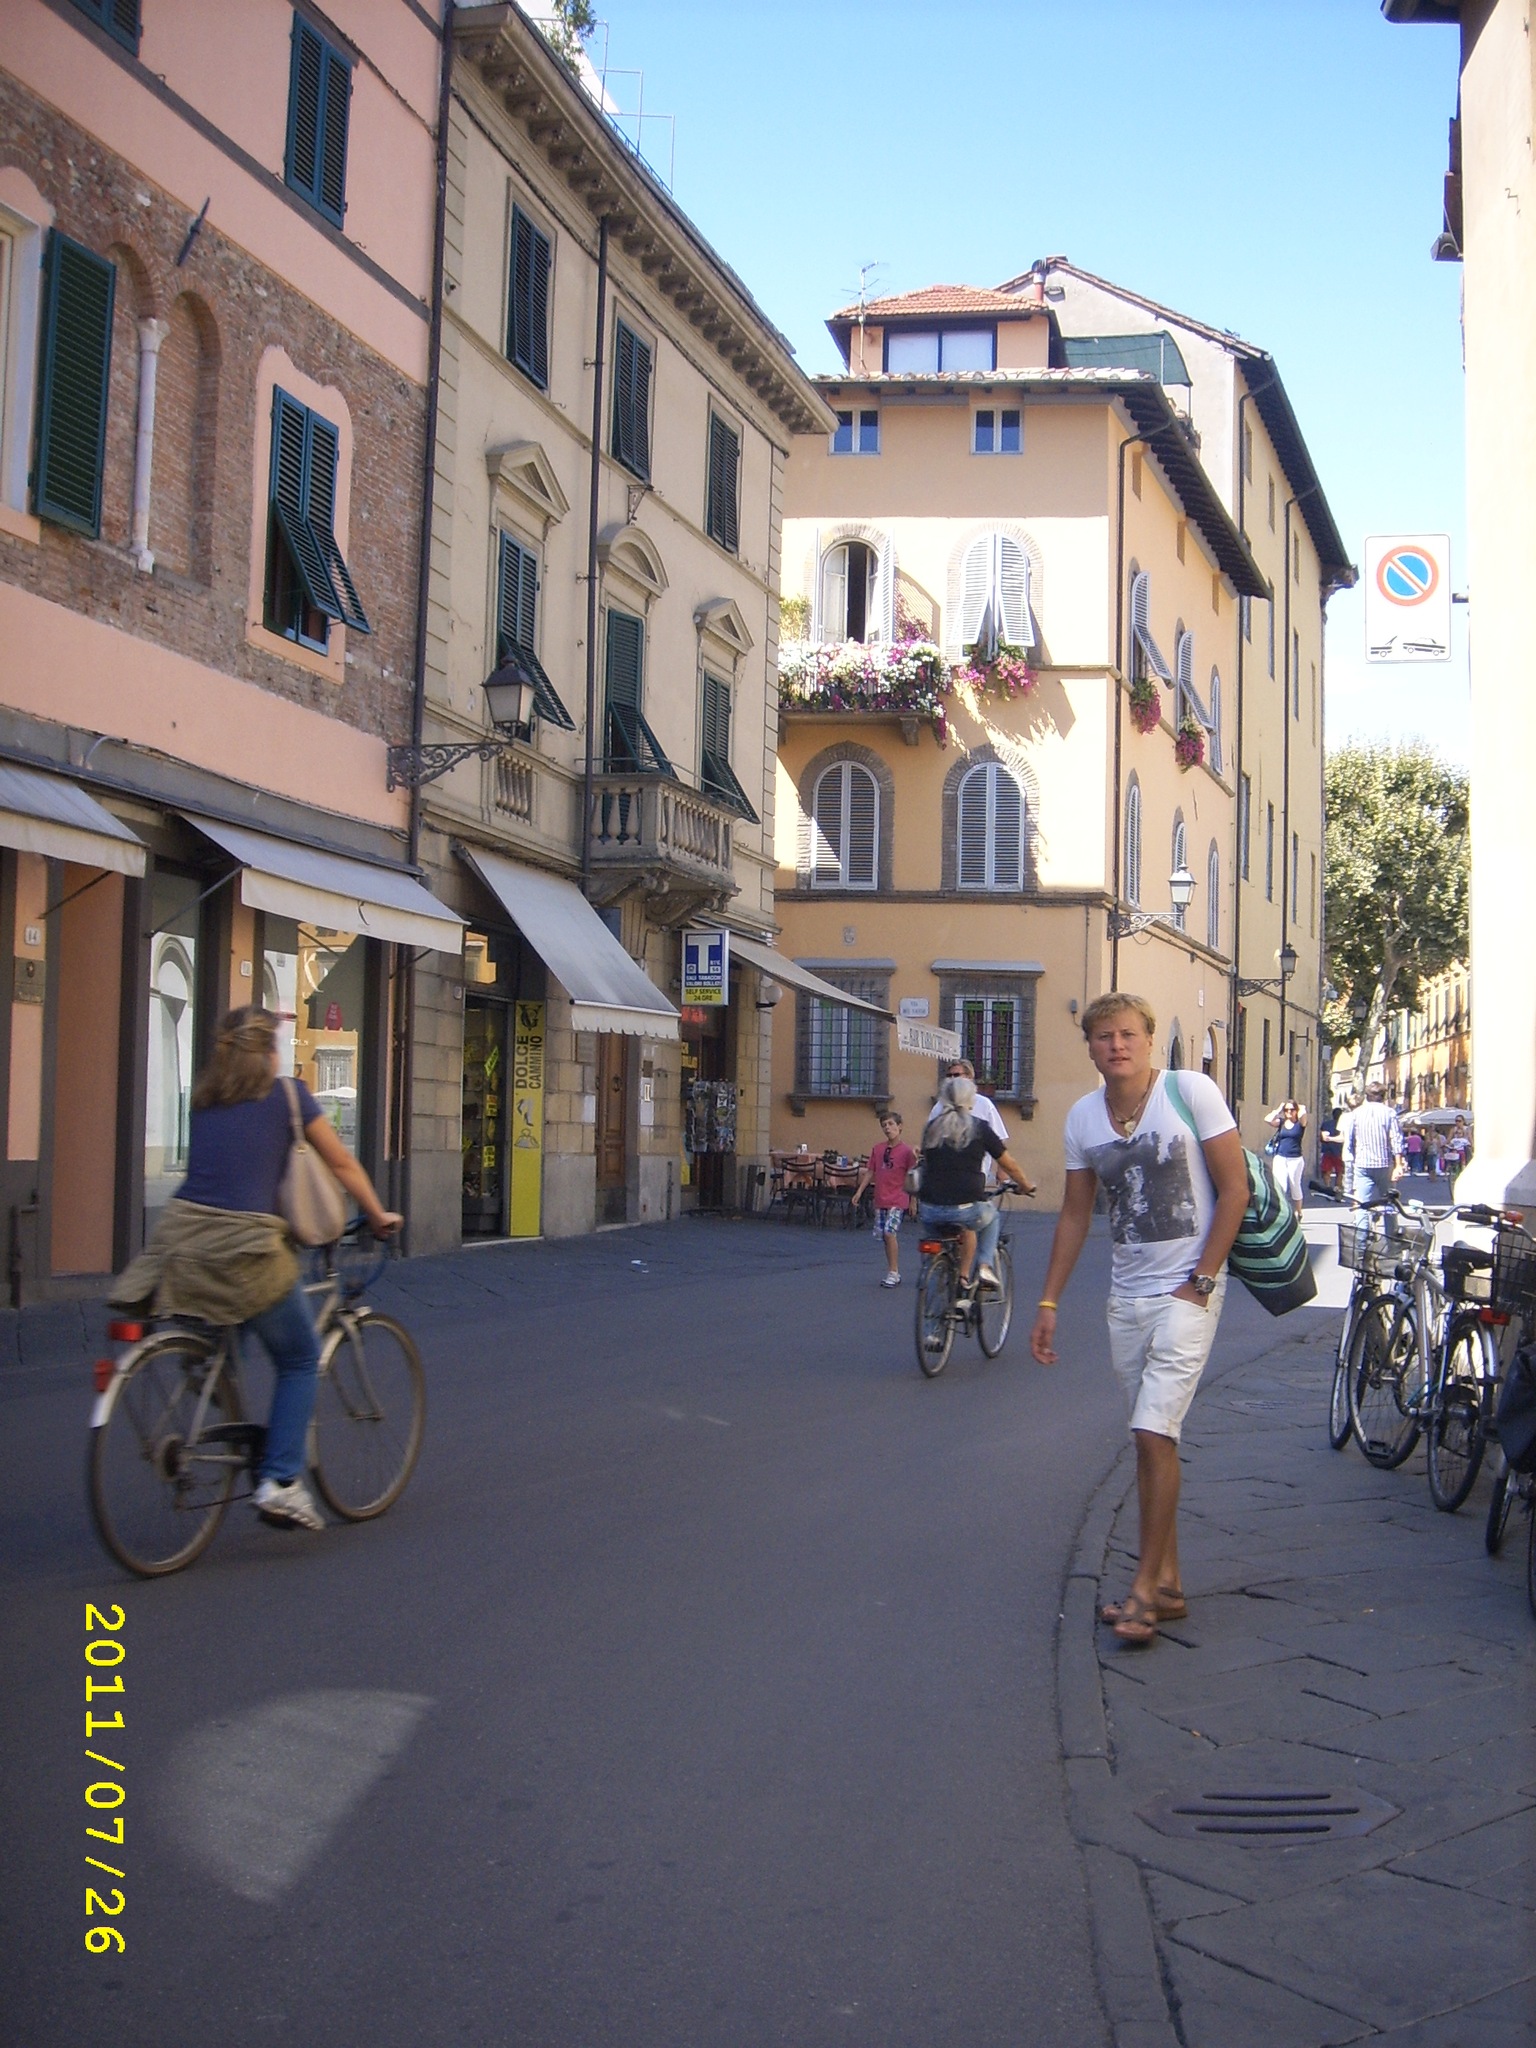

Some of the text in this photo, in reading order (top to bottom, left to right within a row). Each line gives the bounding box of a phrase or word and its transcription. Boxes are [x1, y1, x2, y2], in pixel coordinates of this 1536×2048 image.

[686, 934, 721, 974] T
[515, 1035, 529, 1089] DOLCE
[529, 1035, 542, 1089] CAMMINO
